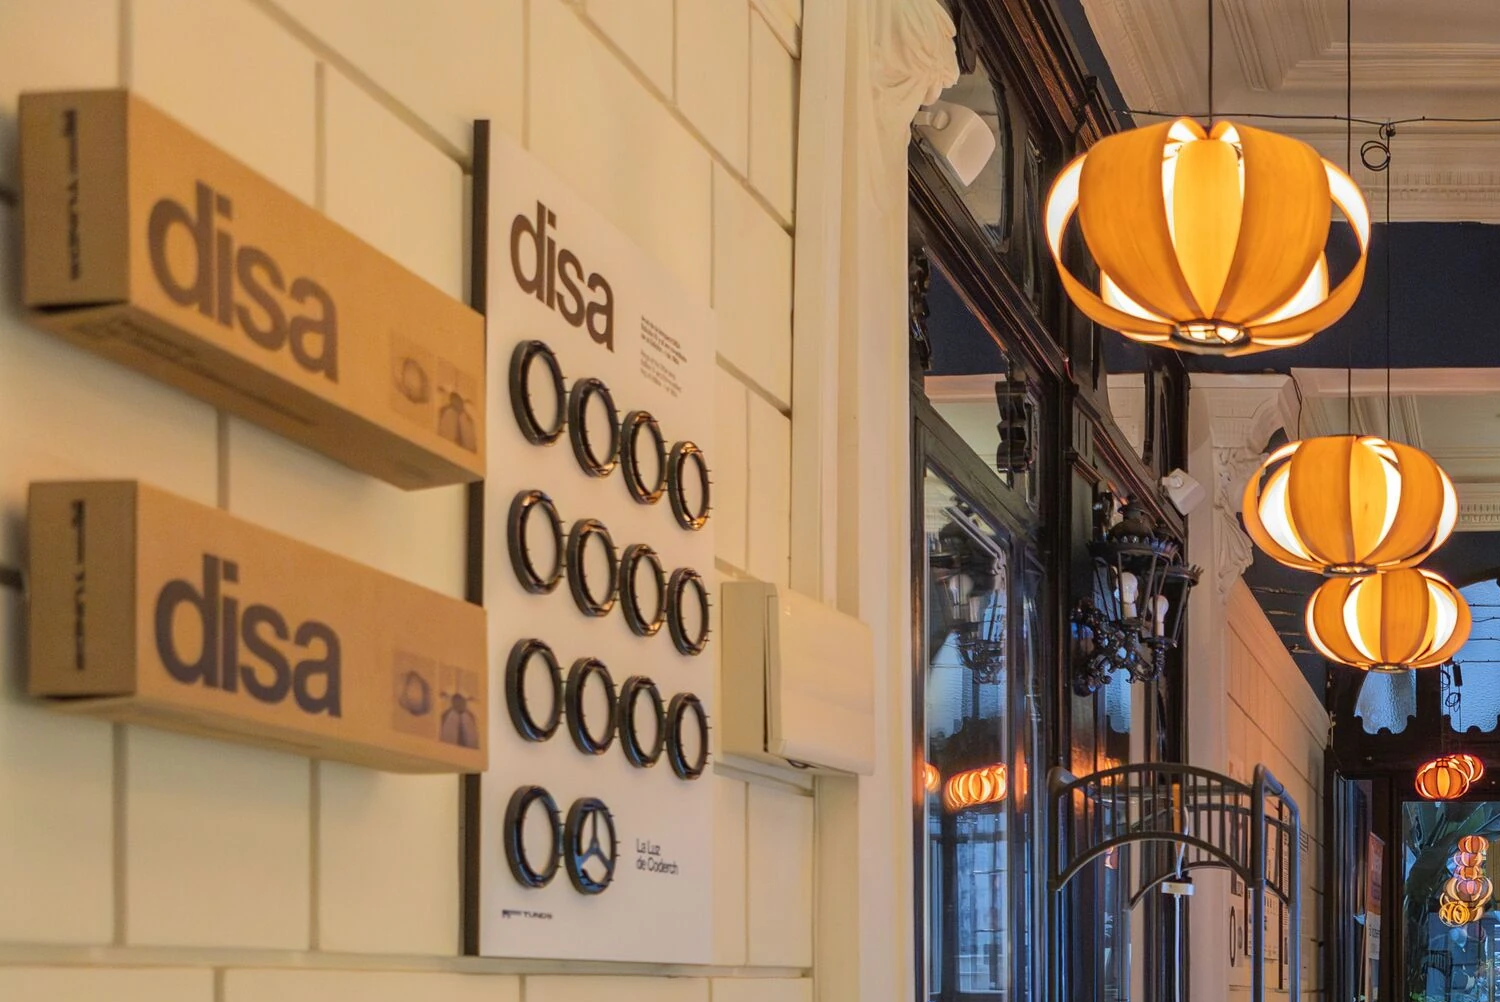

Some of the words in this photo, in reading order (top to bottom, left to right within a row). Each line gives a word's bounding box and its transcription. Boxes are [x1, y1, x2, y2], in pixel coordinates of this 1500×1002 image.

[148, 181, 338, 383] disa
[510, 200, 615, 354] disa
[155, 553, 342, 717] disa
[636, 838, 647, 854] La
[647, 842, 661, 856] Luz
[636, 857, 646, 871] de
[647, 857, 679, 875] Coderch
